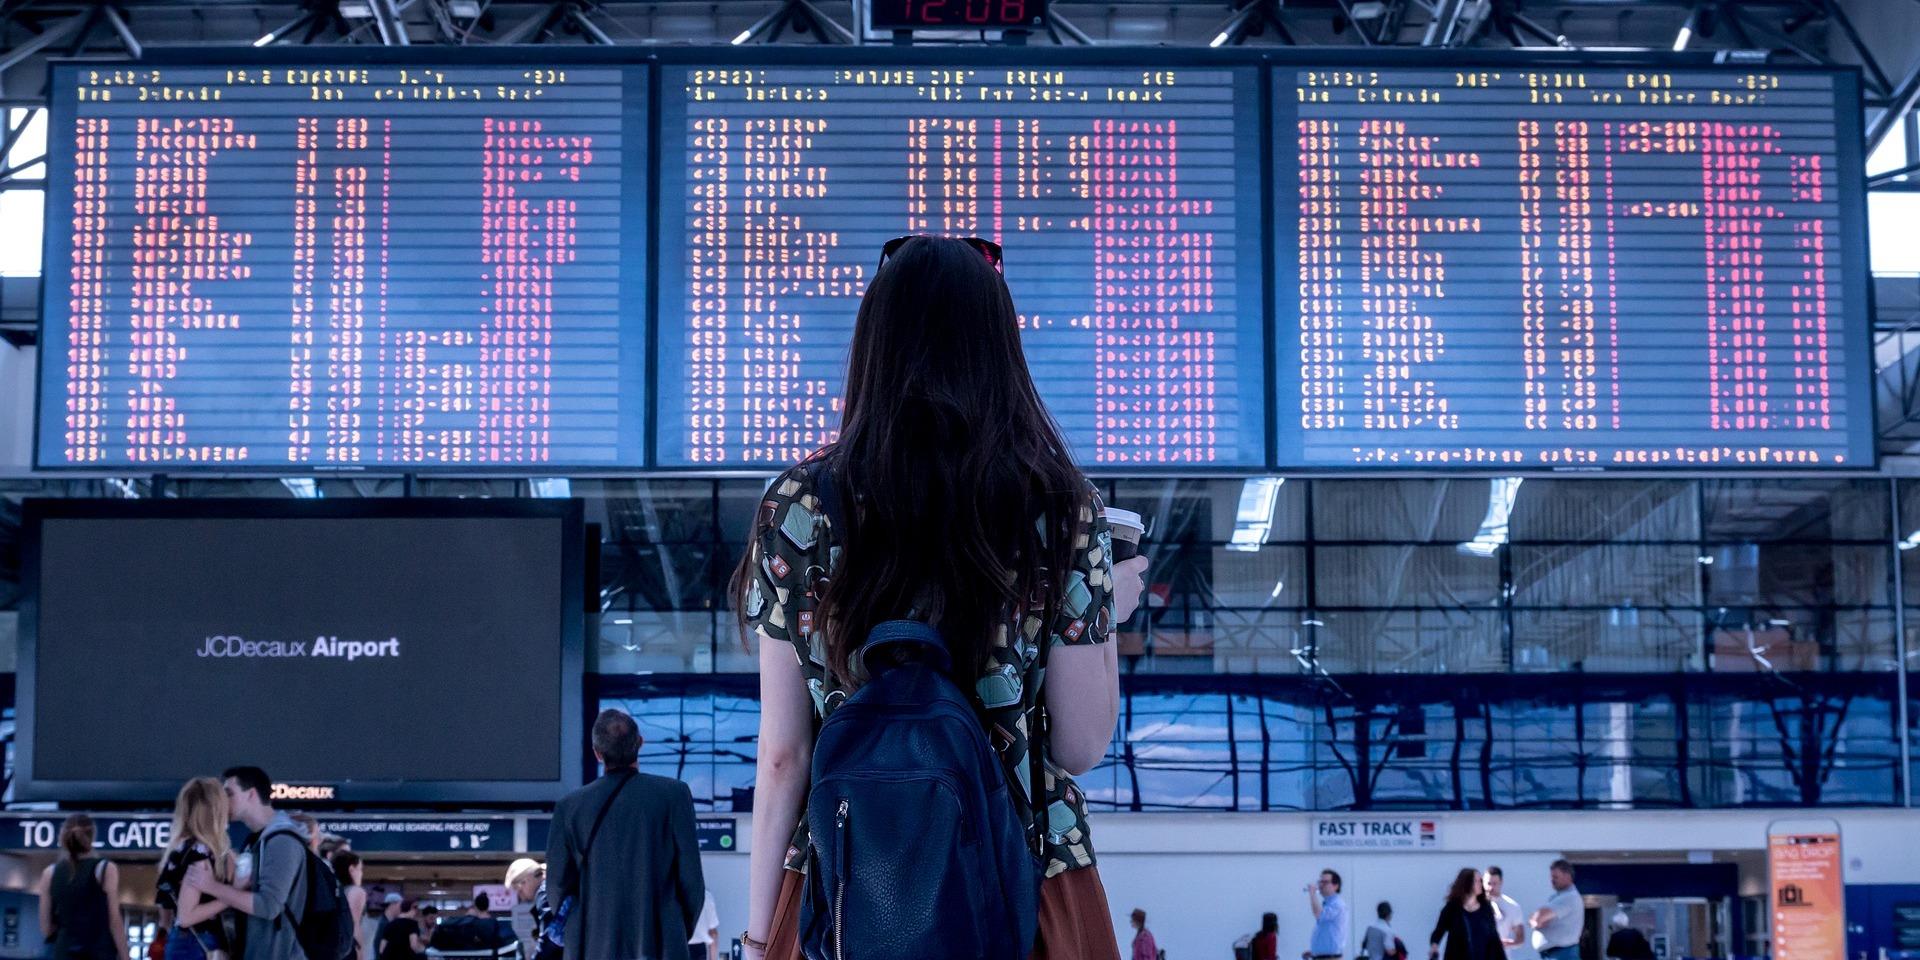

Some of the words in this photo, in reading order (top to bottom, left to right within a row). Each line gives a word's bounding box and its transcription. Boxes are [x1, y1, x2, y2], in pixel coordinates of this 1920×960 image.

[196, 635, 306, 657] JCDecaux
[311, 636, 400, 661] Airport
[19, 820, 54, 848] TO
[327, 822, 347, 832] YOUR
[348, 822, 387, 832] PASSPORT
[388, 822, 404, 832] AND
[405, 822, 443, 832] BOARDING
[444, 822, 463, 832] PASS
[464, 822, 490, 832] READY
[1319, 822, 1356, 836] FAST
[1362, 822, 1412, 836] TRACK
